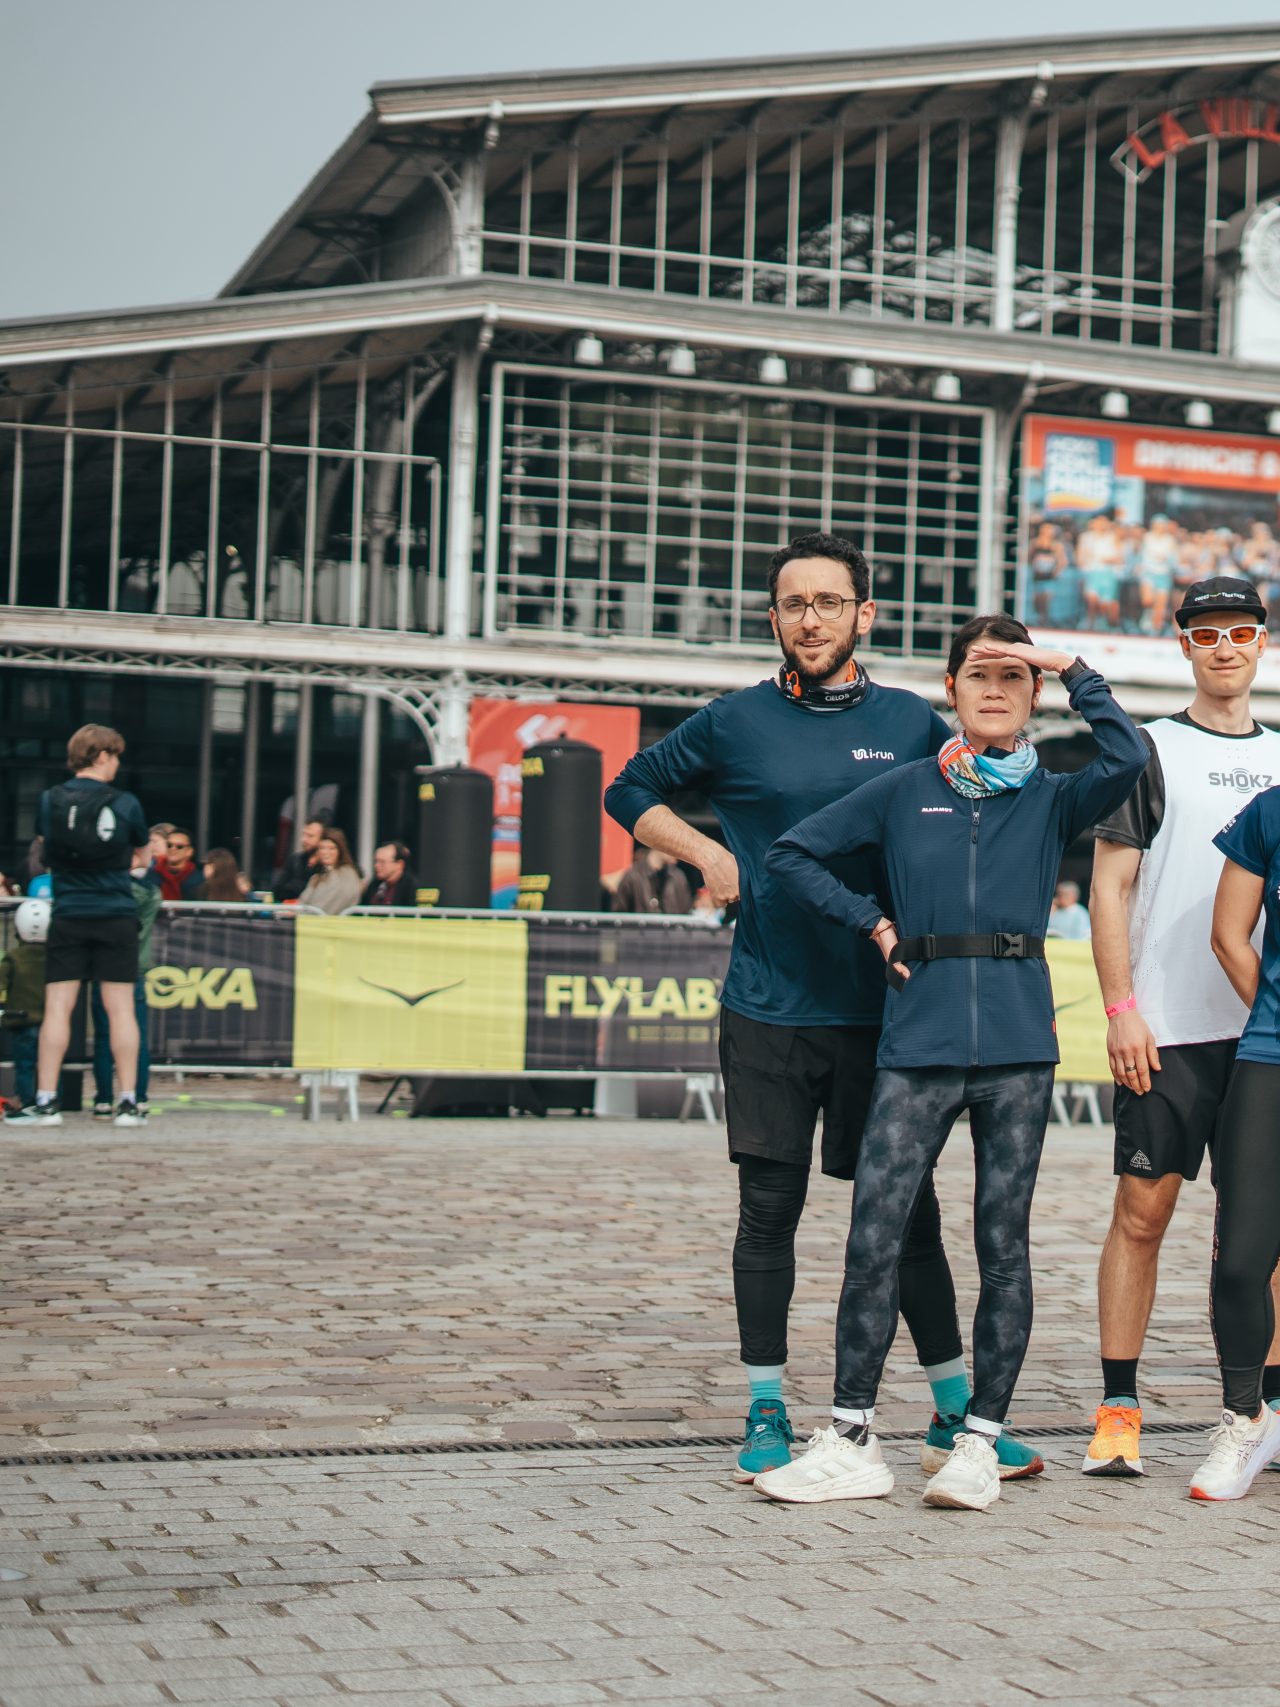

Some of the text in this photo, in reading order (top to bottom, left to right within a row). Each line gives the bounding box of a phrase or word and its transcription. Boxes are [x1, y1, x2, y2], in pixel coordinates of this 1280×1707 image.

[1128, 112, 1192, 170] LA
[869, 748, 895, 760] i-run
[1208, 770, 1274, 791] SHOKZ
[144, 965, 258, 1010] OKA
[544, 974, 721, 1021] FLYLAB
